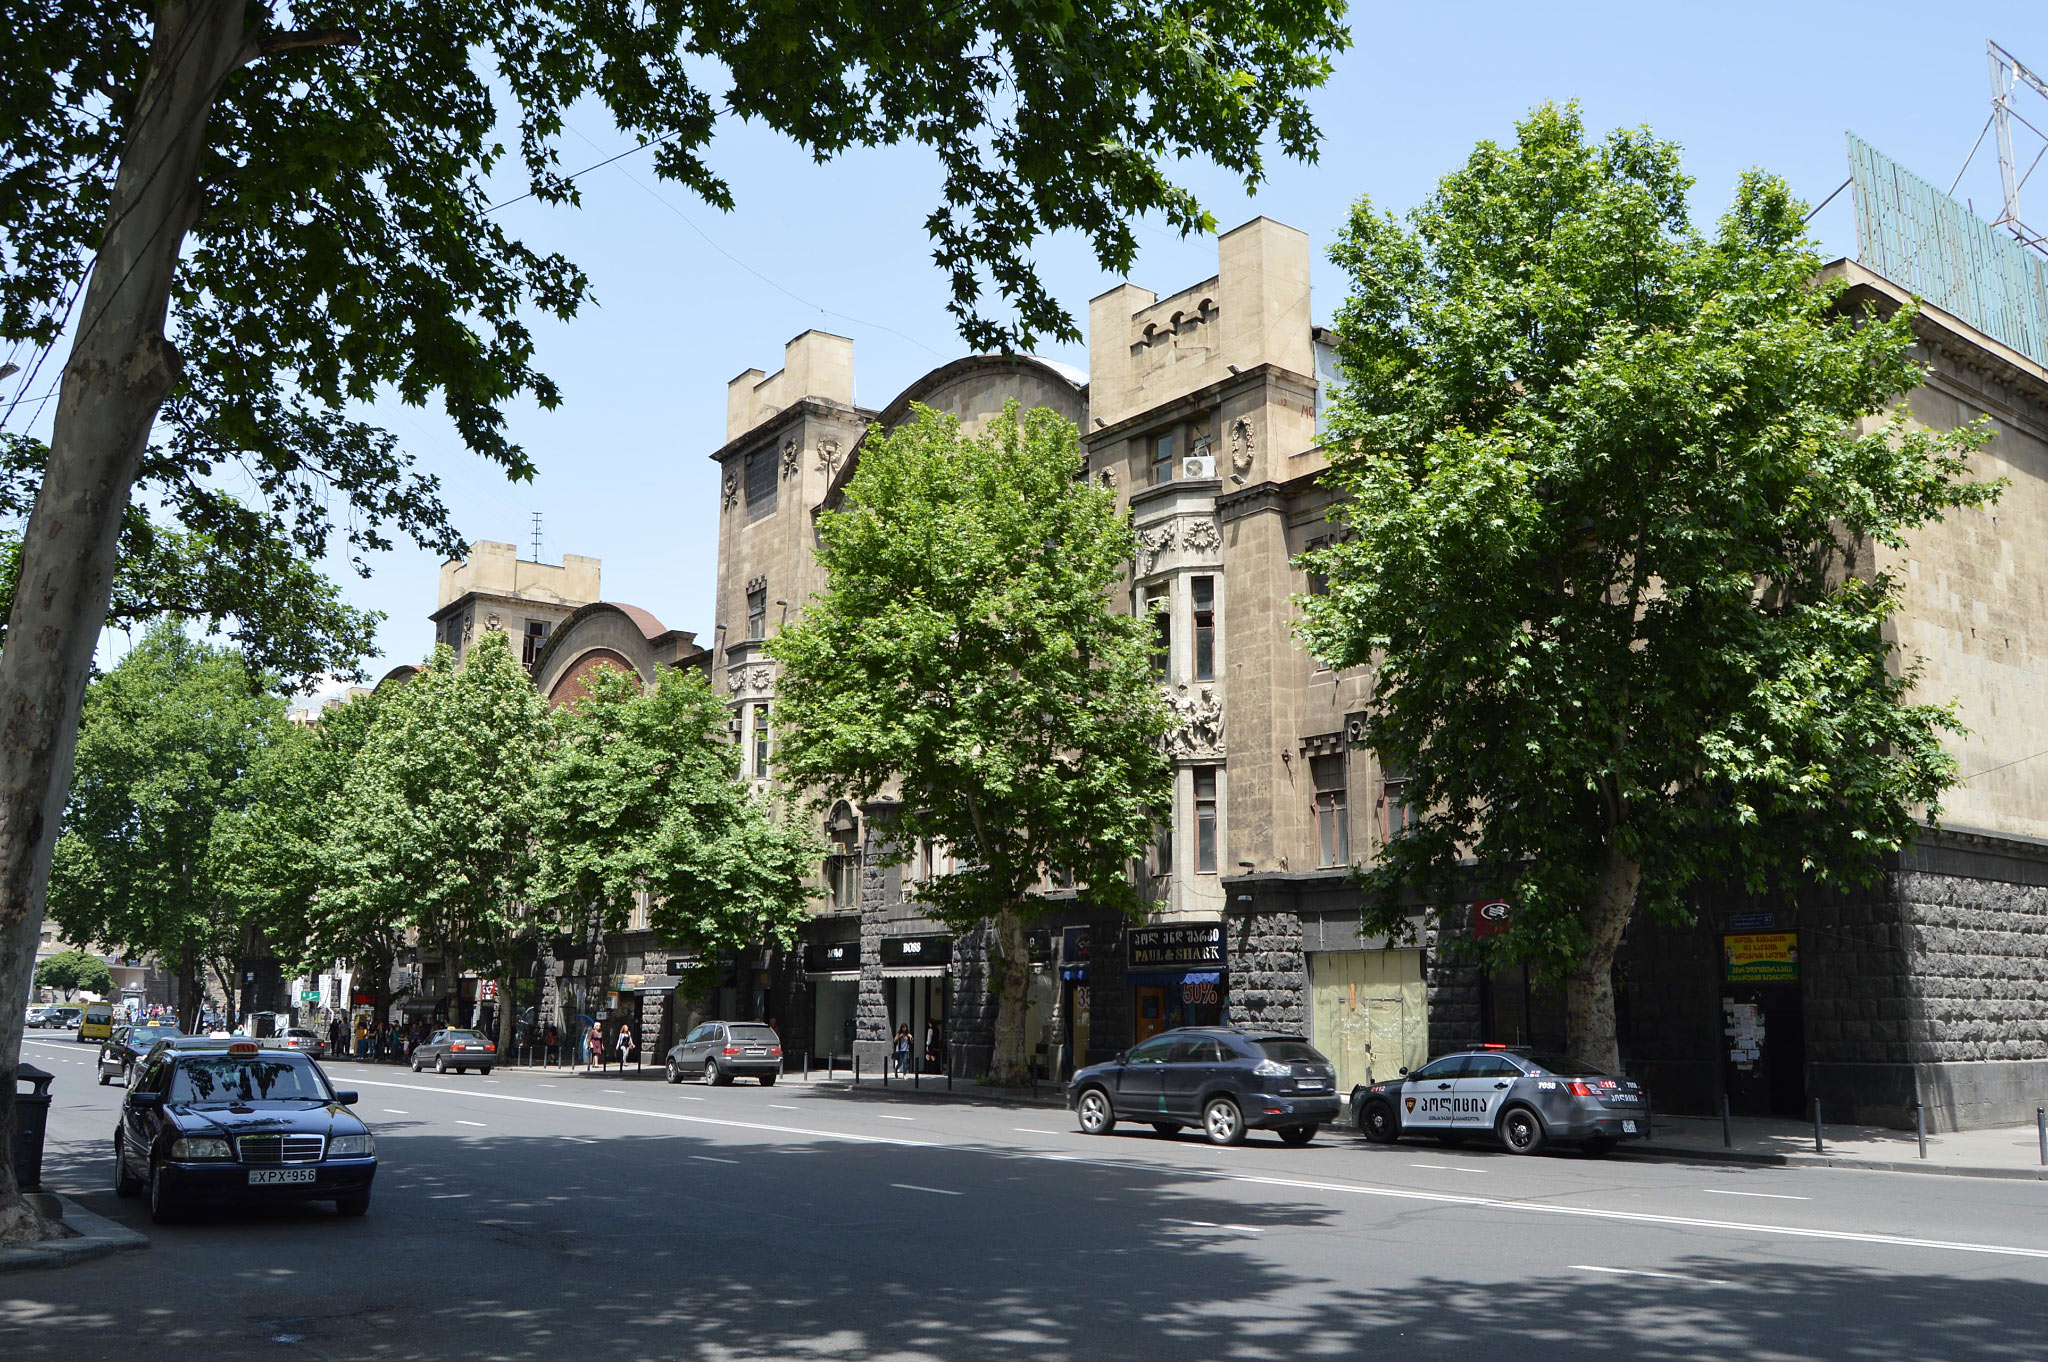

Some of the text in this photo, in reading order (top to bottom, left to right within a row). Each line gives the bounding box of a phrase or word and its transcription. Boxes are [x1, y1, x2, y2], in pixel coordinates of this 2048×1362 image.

[1135, 932, 1159, 945] პოლ
[1163, 931, 1183, 945] ენდ
[903, 942, 921, 953] BOSS
[1135, 949, 1163, 962] PAUL
[1175, 946, 1220, 960] SHARK
[1183, 983, 1218, 1004] 50%
[236, 1044, 255, 1052] TAXI
[1538, 1082, 1556, 1090] 7058
[1421, 1098, 1487, 1112] პოლიცია
